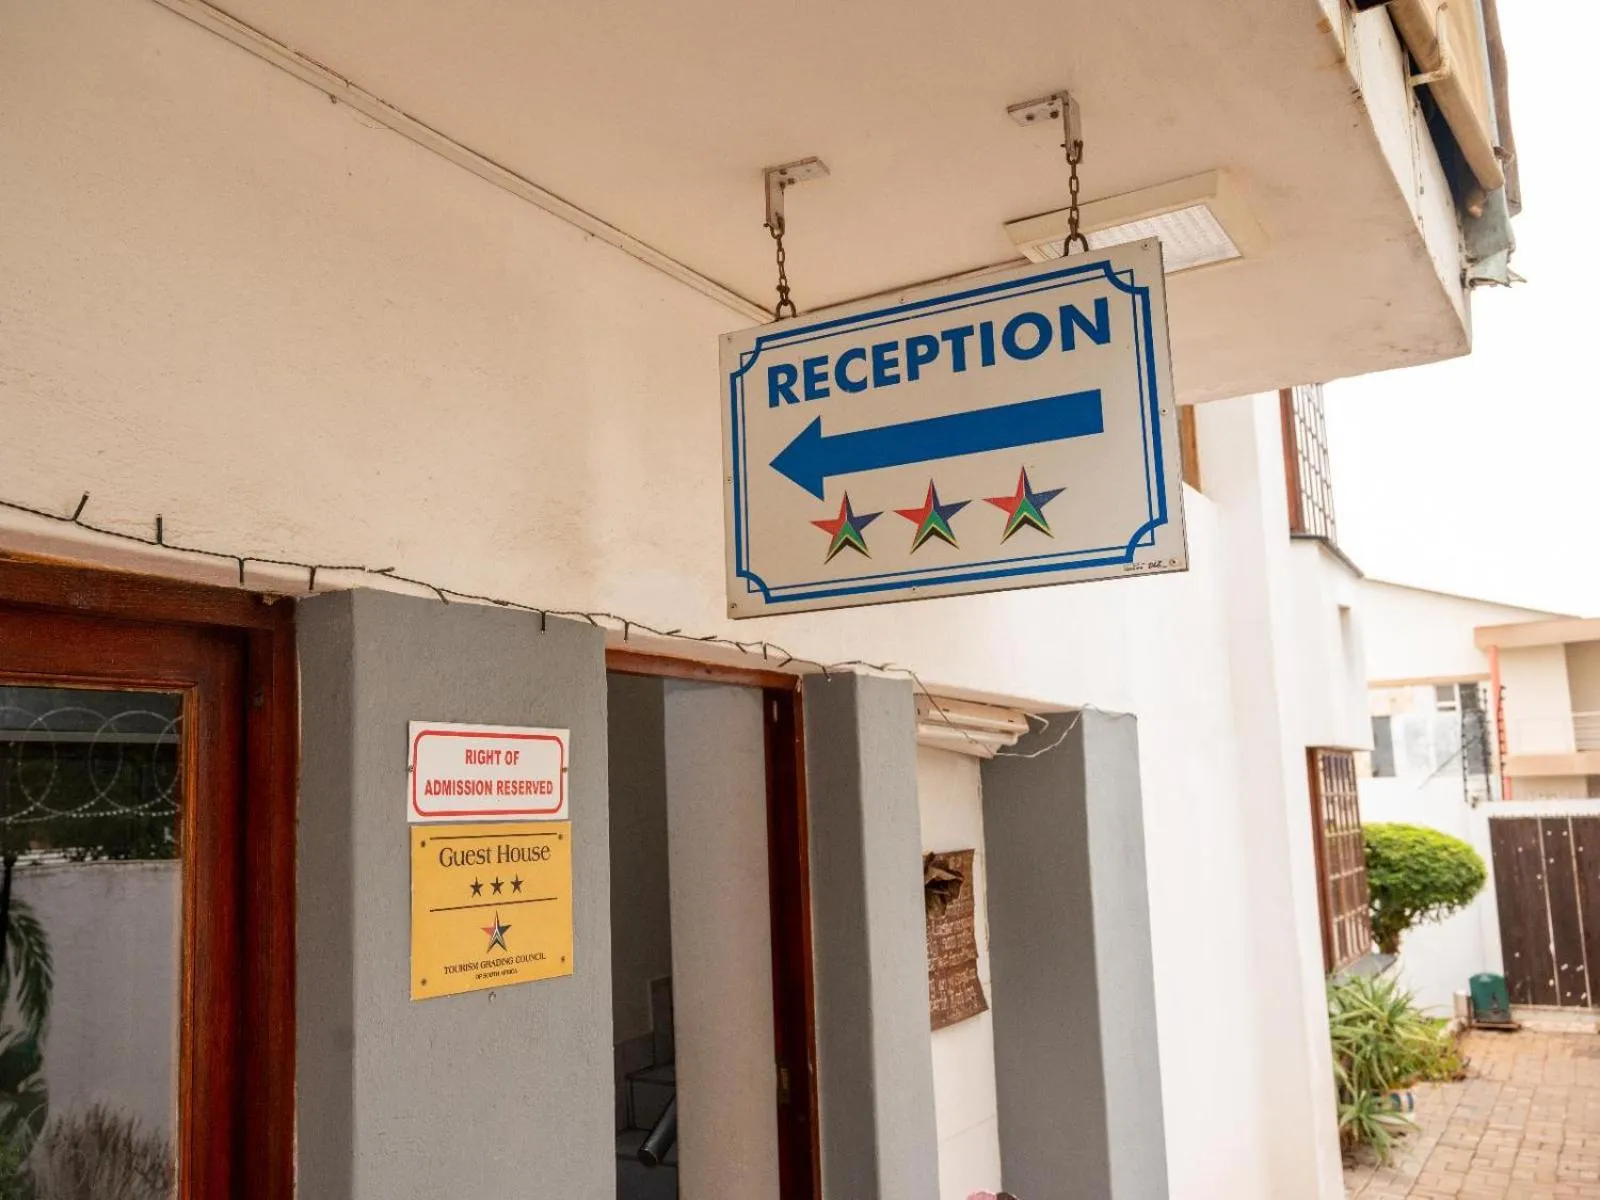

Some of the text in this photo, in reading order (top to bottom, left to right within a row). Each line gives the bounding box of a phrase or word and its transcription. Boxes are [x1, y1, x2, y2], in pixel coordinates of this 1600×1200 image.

[767, 297, 1111, 408] RECEPTION
[465, 749, 520, 765] RIGHT OF
[424, 780, 553, 796] ADMISSION RESERVED
[439, 844, 550, 868] Guest House
[444, 952, 546, 975] TOURISM GRADING COUNCIL
